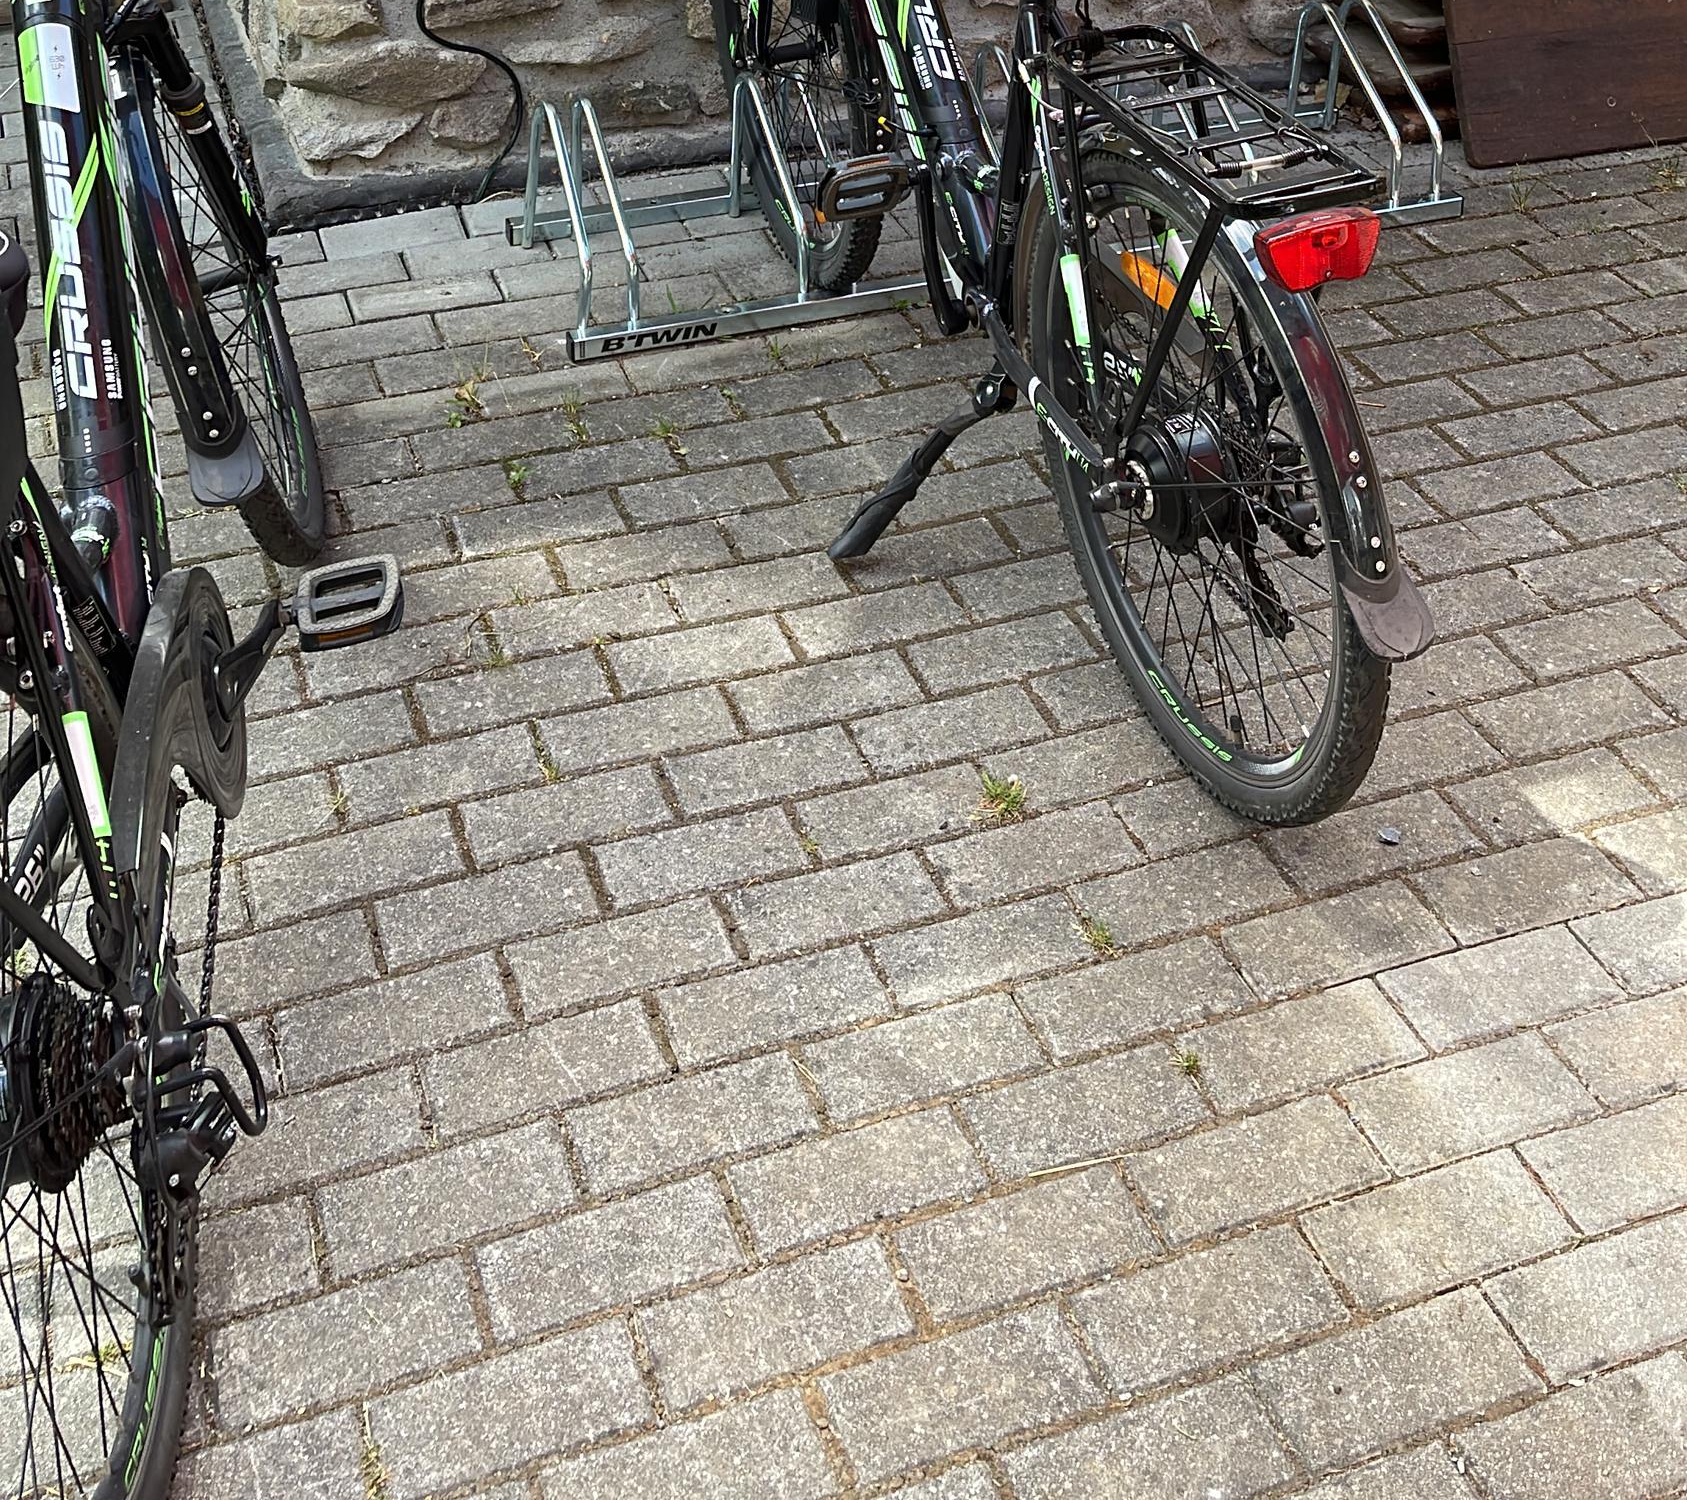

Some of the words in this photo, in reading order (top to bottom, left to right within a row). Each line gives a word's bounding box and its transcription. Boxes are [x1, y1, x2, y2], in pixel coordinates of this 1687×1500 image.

[912, 43, 934, 90] SAMSUNG
[38, 119, 98, 400] CRUSSIS
[101, 338, 119, 400] SAMSUNG
